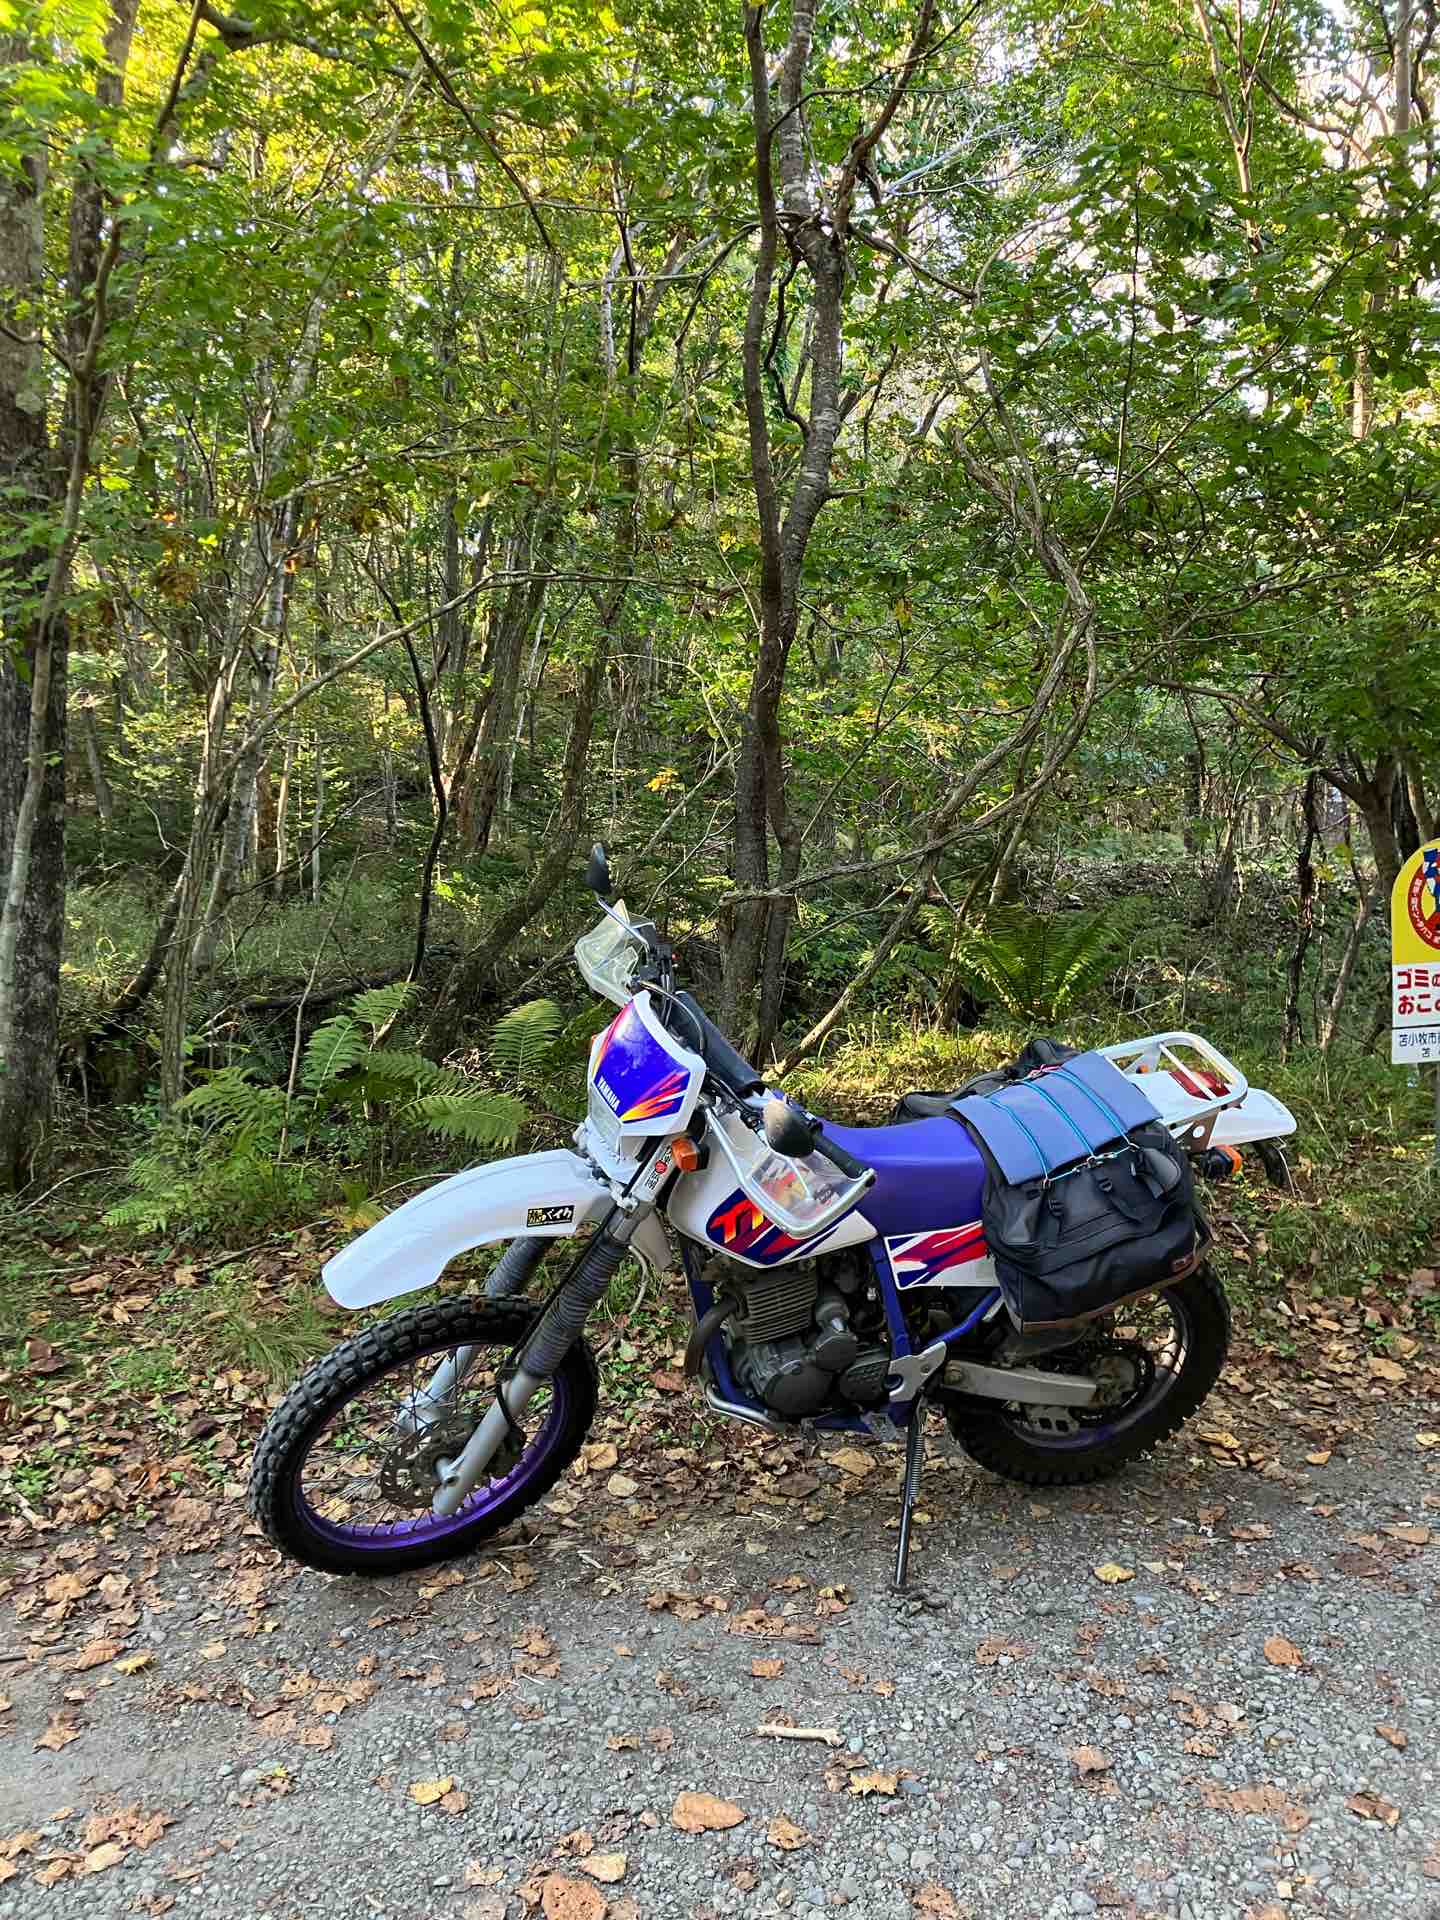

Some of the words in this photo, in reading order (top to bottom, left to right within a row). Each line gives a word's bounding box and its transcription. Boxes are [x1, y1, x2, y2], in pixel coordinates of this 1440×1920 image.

[1399, 1031, 1440, 1047] 苫小牧市
[597, 1075, 620, 1111] YAMAHA
